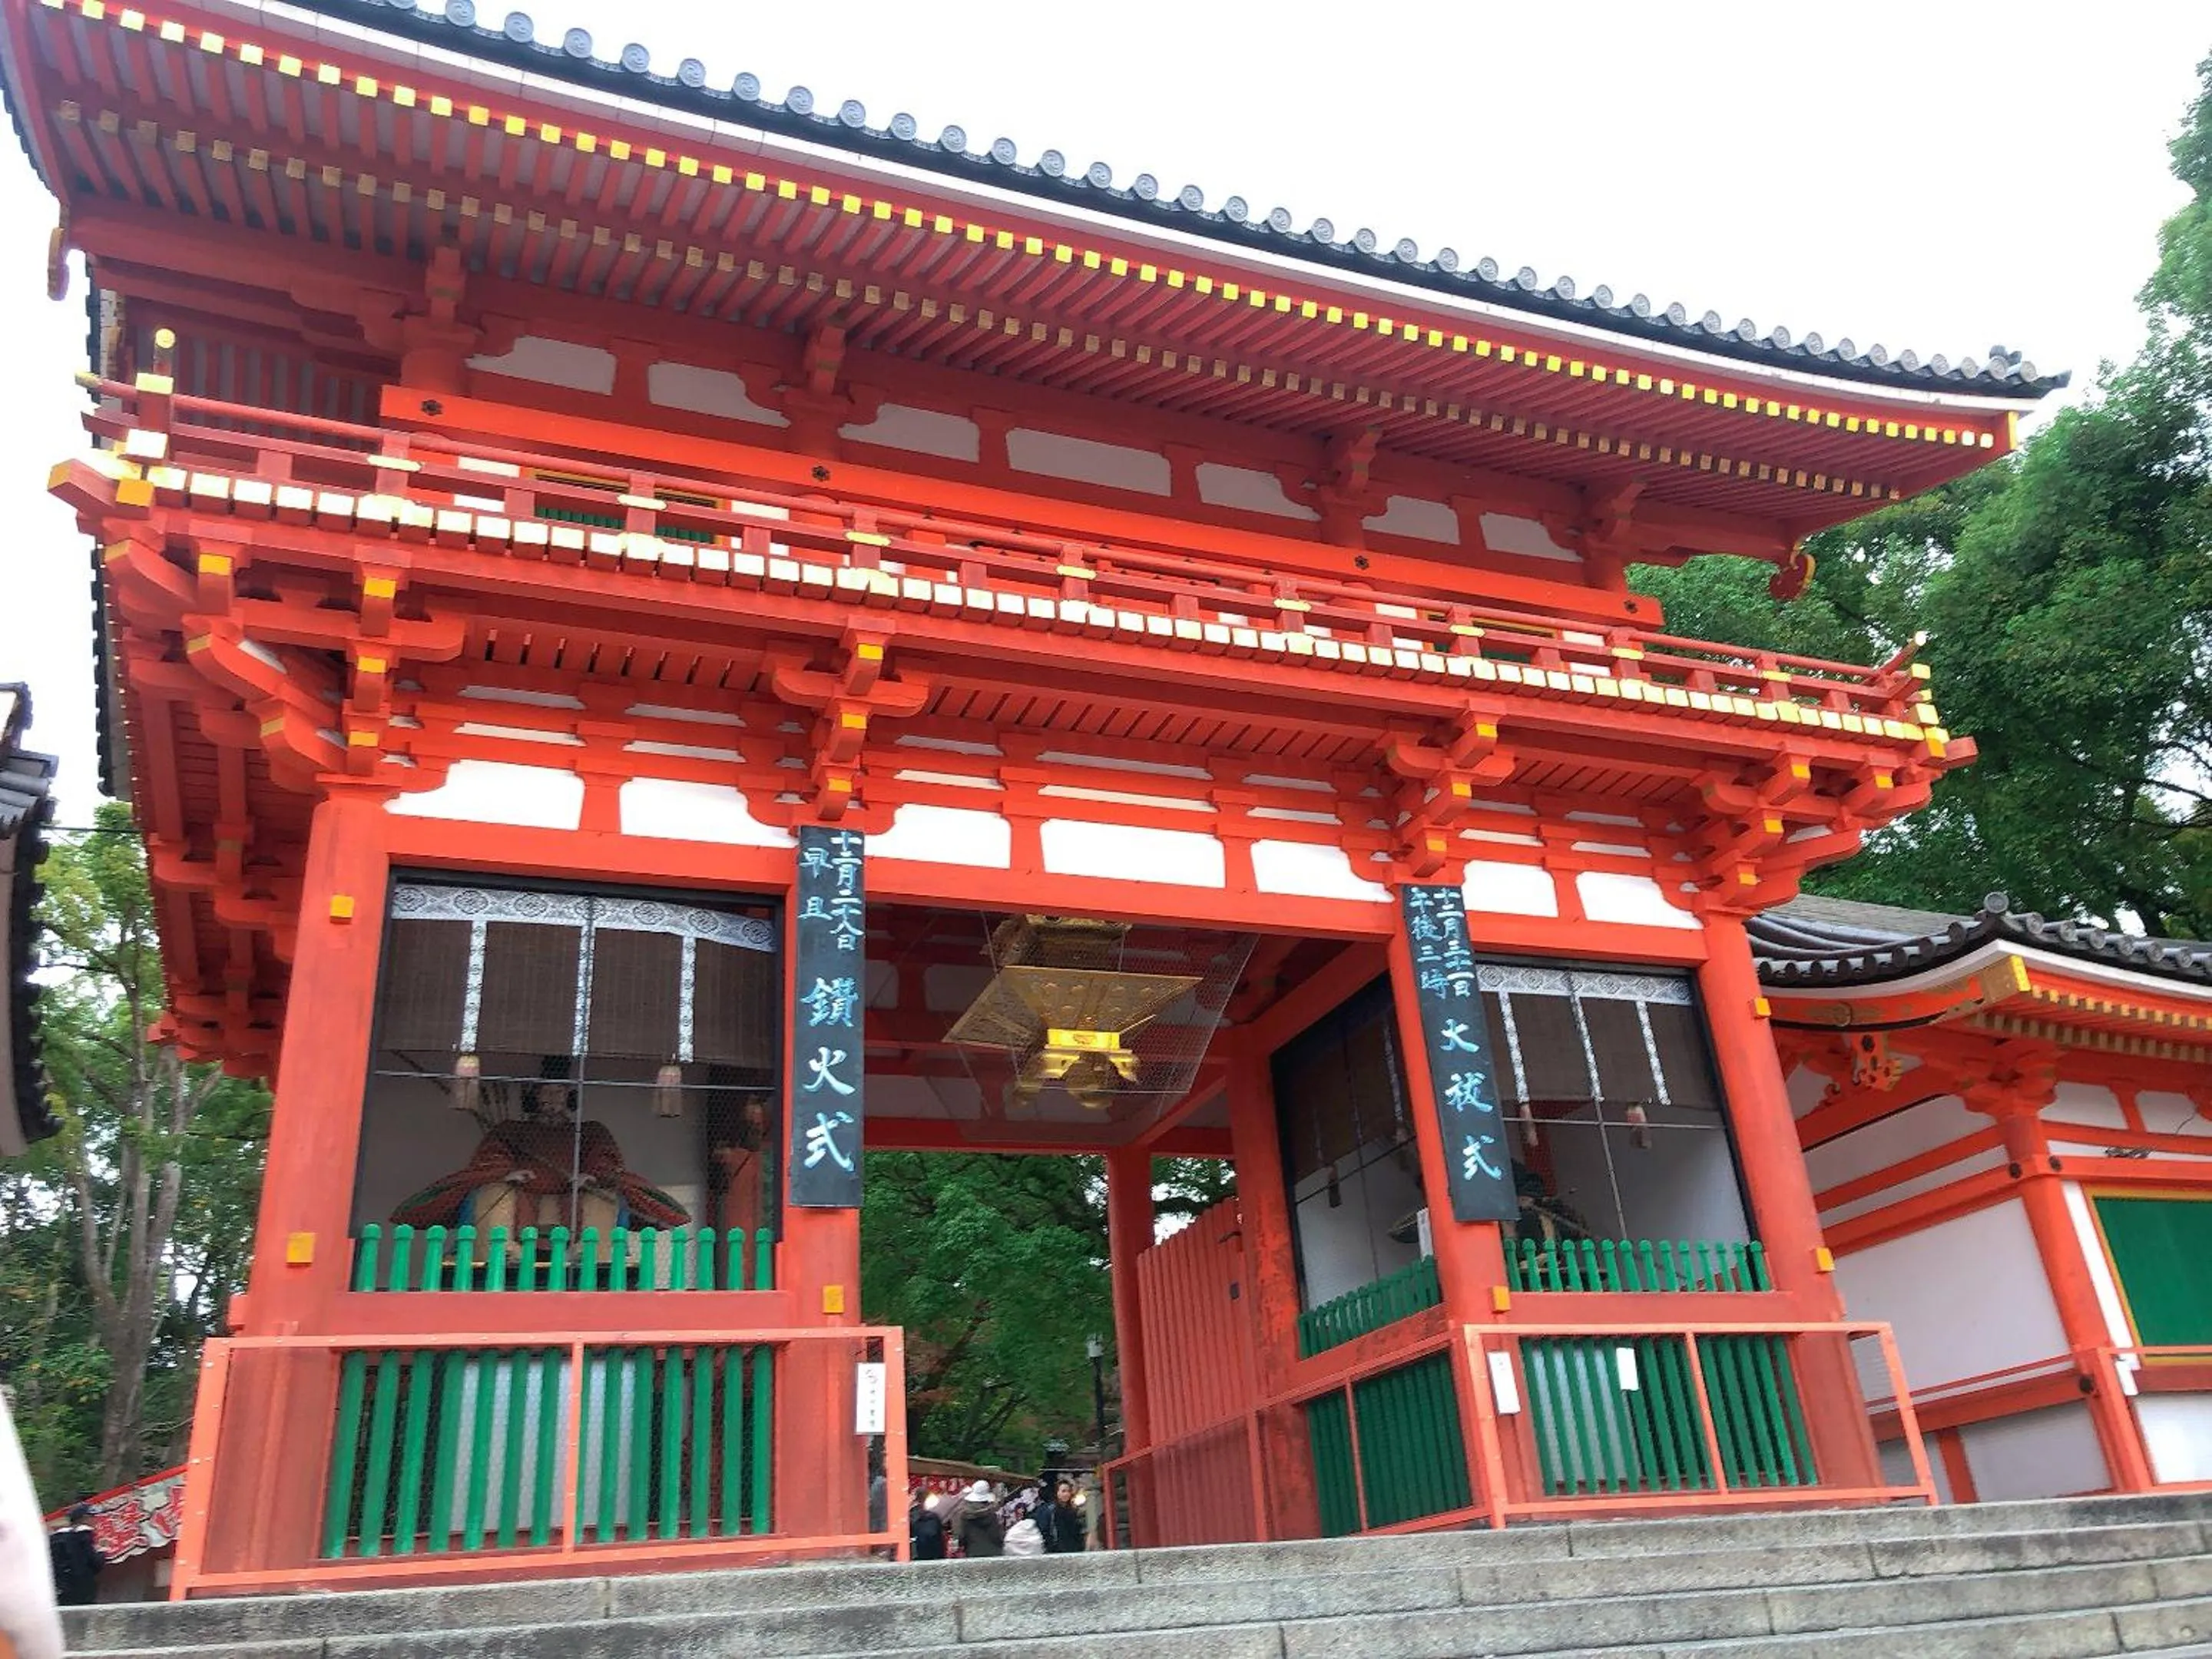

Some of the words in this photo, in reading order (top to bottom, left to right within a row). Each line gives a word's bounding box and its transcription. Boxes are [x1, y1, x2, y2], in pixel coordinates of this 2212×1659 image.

[830, 831, 865, 951] 十二月二十八日
[1409, 886, 1449, 999] 午後三時
[1433, 886, 1476, 998] 十二月三十一日
